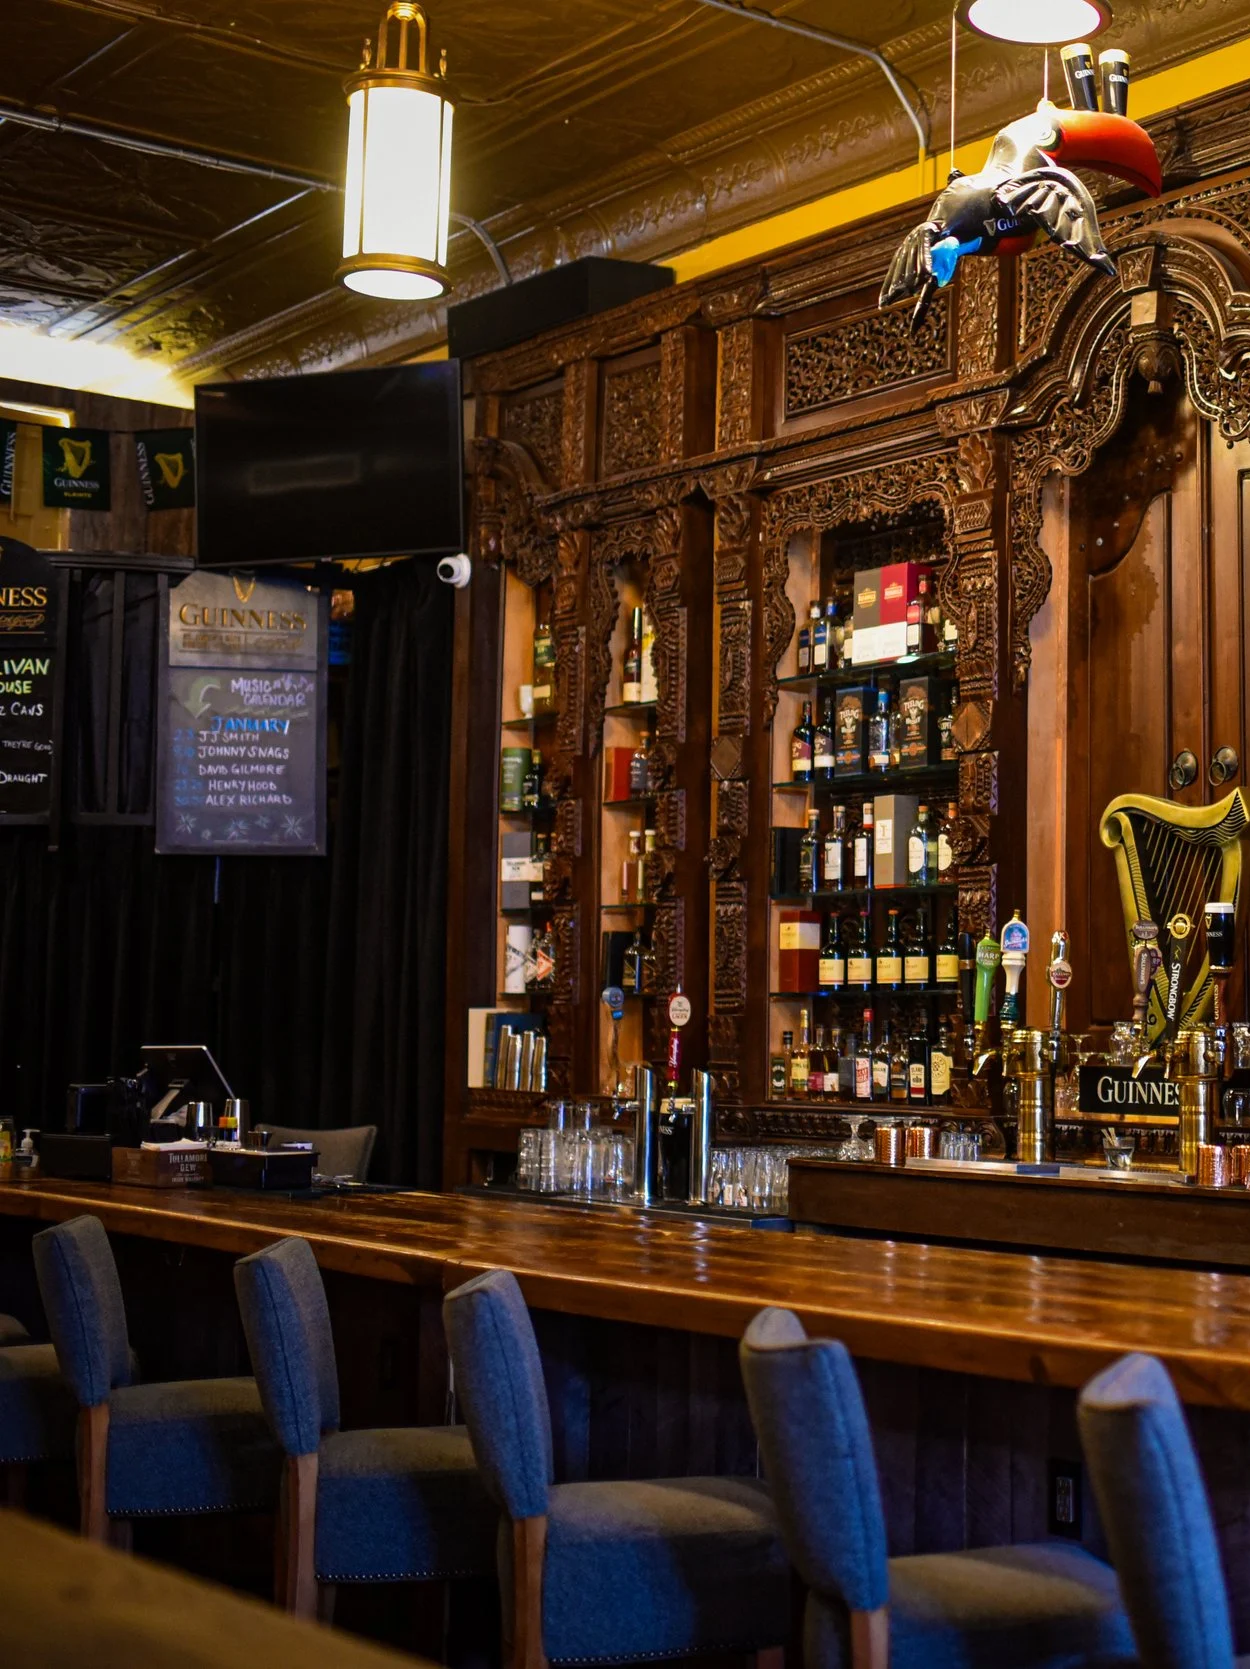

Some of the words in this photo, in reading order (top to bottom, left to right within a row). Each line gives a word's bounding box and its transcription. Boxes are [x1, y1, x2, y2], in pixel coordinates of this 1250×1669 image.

[54, 477, 100, 489] GUINNESS
[179, 603, 307, 630] GUINNESS
[231, 677, 272, 696] MUSIC
[243, 693, 307, 707] CALENDAR
[211, 716, 290, 735] JANUARY
[222, 731, 259, 743] SMITH
[198, 745, 247, 759] JOHNNY
[247, 746, 290, 760] SNAGS
[199, 764, 228, 776] DAVID
[231, 764, 287, 776] GILMORE
[208, 779, 246, 791] HENRY
[205, 794, 236, 806] ALEX
[239, 794, 293, 806] RICHARD
[978, 952, 999, 960] HARP
[1166, 962, 1181, 1020] STRONGBOW
[168, 1152, 208, 1163] TULLAMORE
